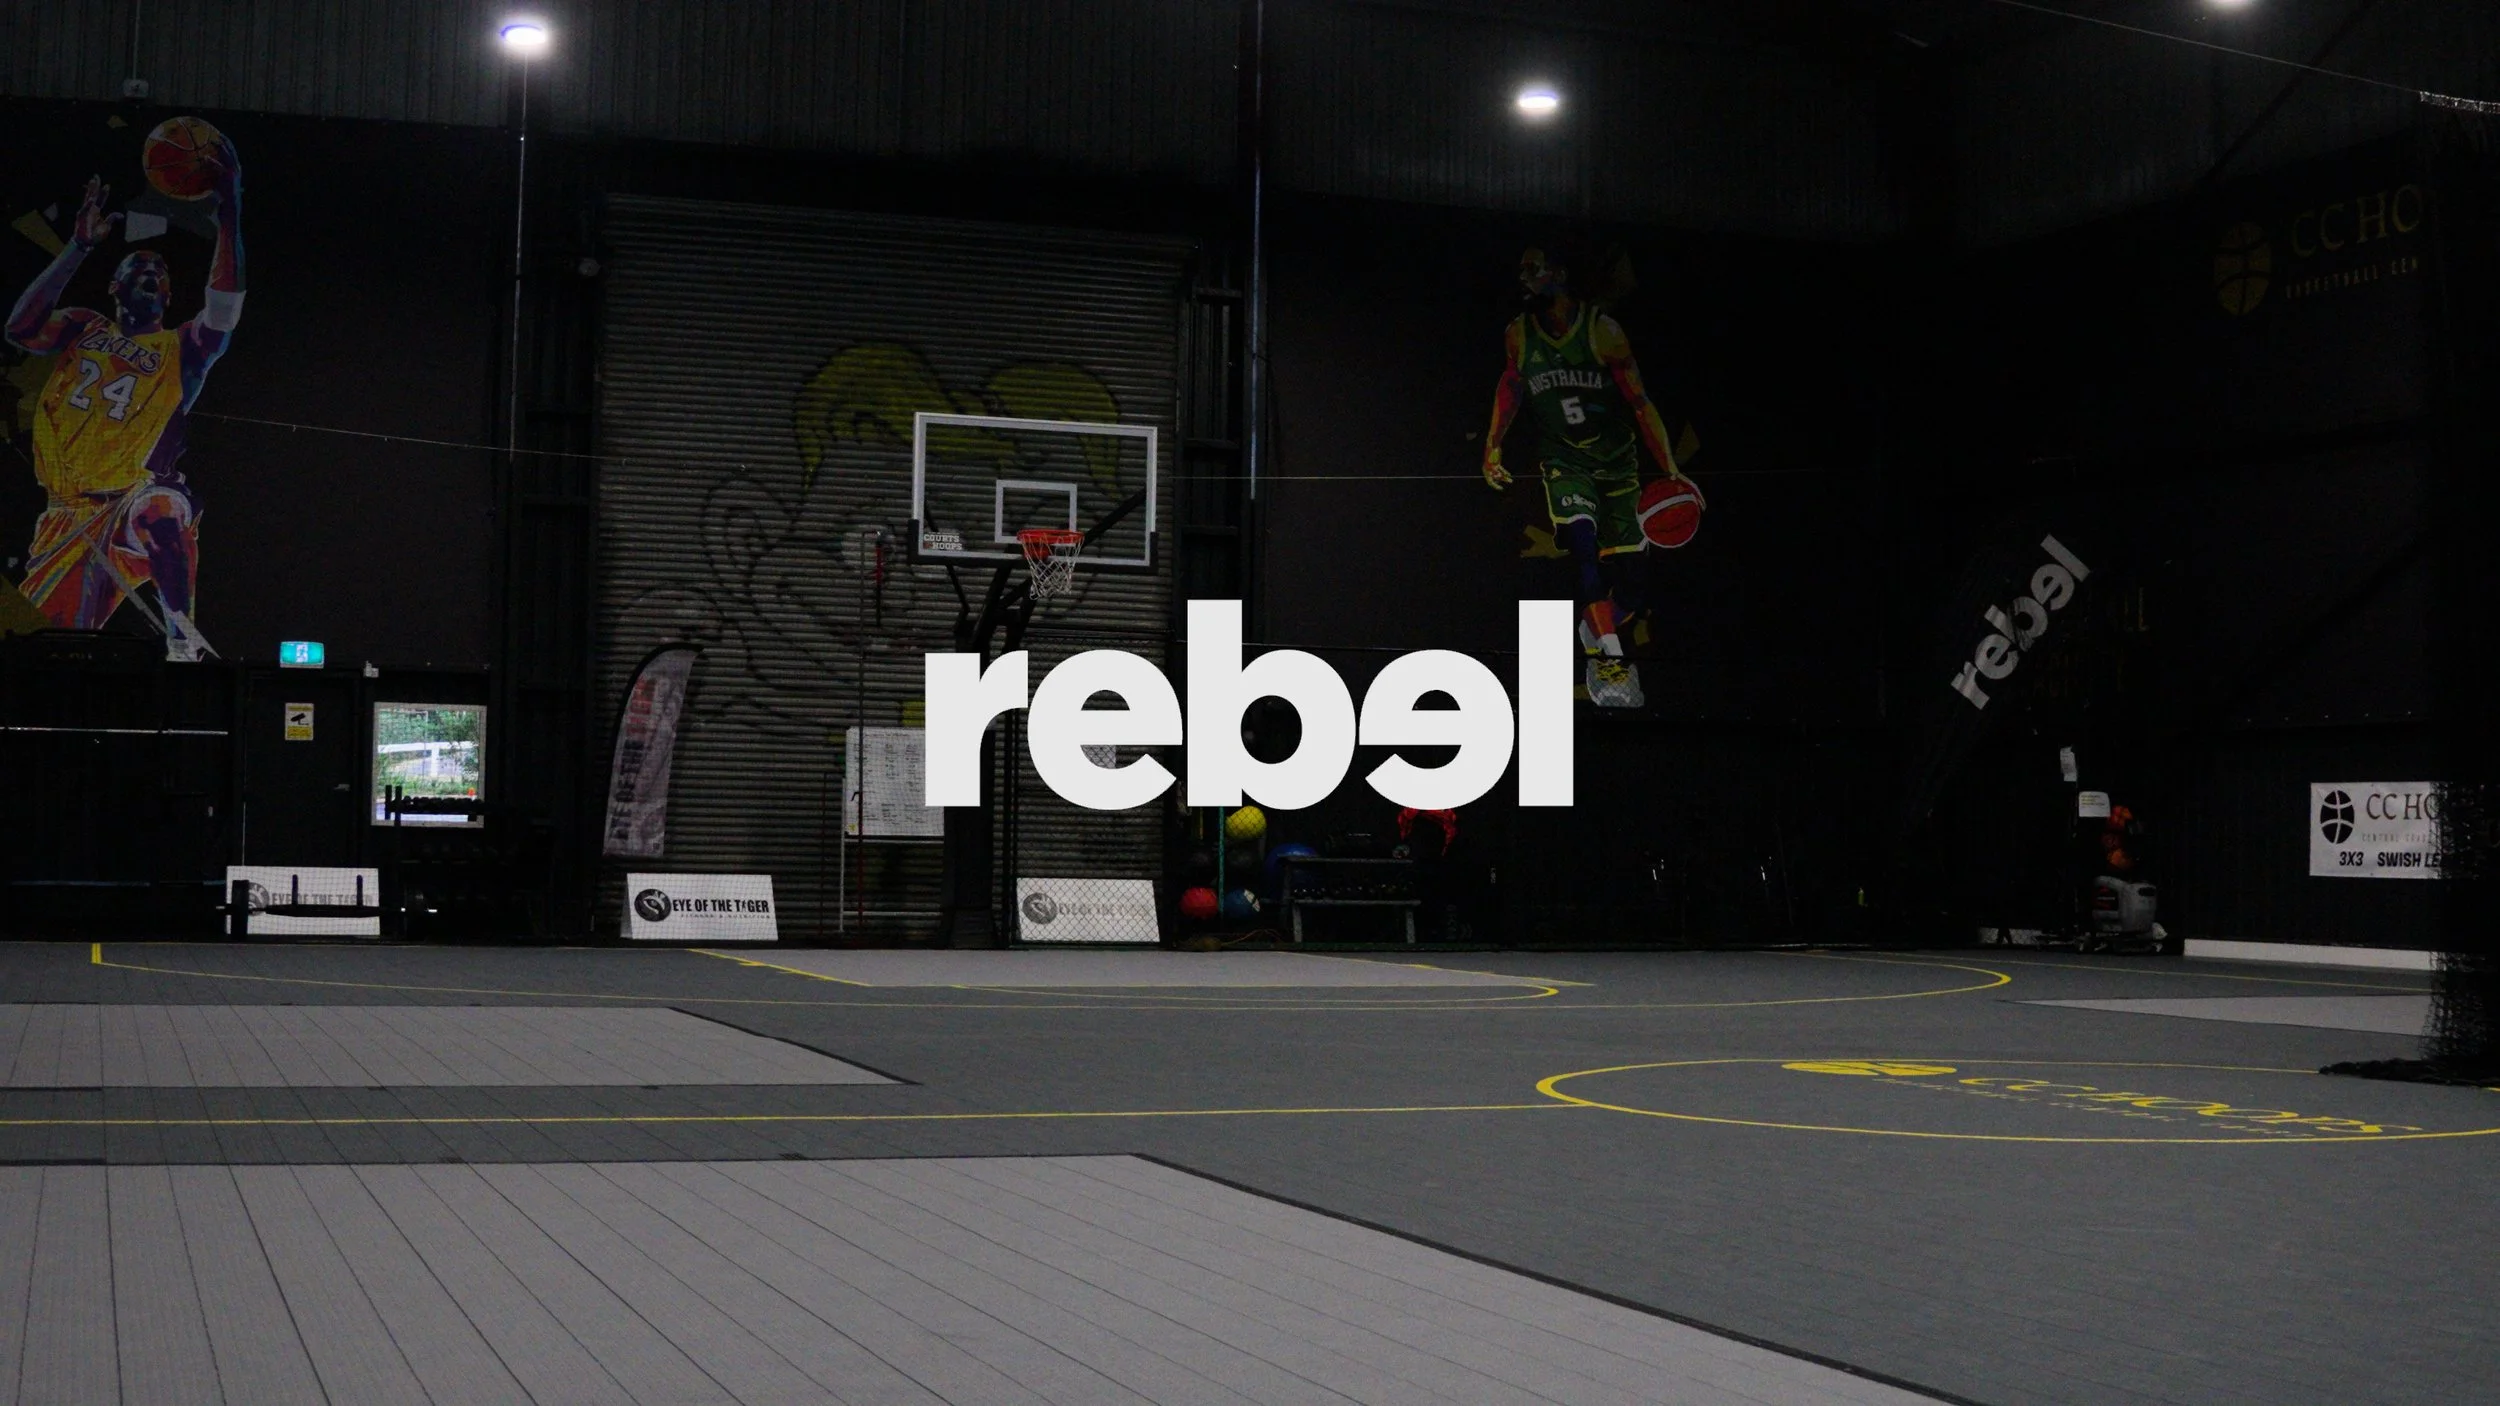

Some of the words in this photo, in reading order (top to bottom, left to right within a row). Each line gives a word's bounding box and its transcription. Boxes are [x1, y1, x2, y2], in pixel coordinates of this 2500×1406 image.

[76, 329, 161, 375] LAKERS
[68, 358, 138, 421] 24
[1527, 368, 1603, 396] AUSTRALIA
[1560, 396, 1586, 425] 5
[923, 533, 960, 543] COURTS
[1950, 533, 2091, 711] rebel
[2366, 794, 2397, 820] CC
[2339, 852, 2364, 866] 3X3
[2377, 852, 2421, 867] SWISH
[673, 899, 692, 911] EYE
[695, 899, 708, 912] OF
[711, 899, 732, 912] THE
[2053, 1091, 2423, 1134] HOOPS
